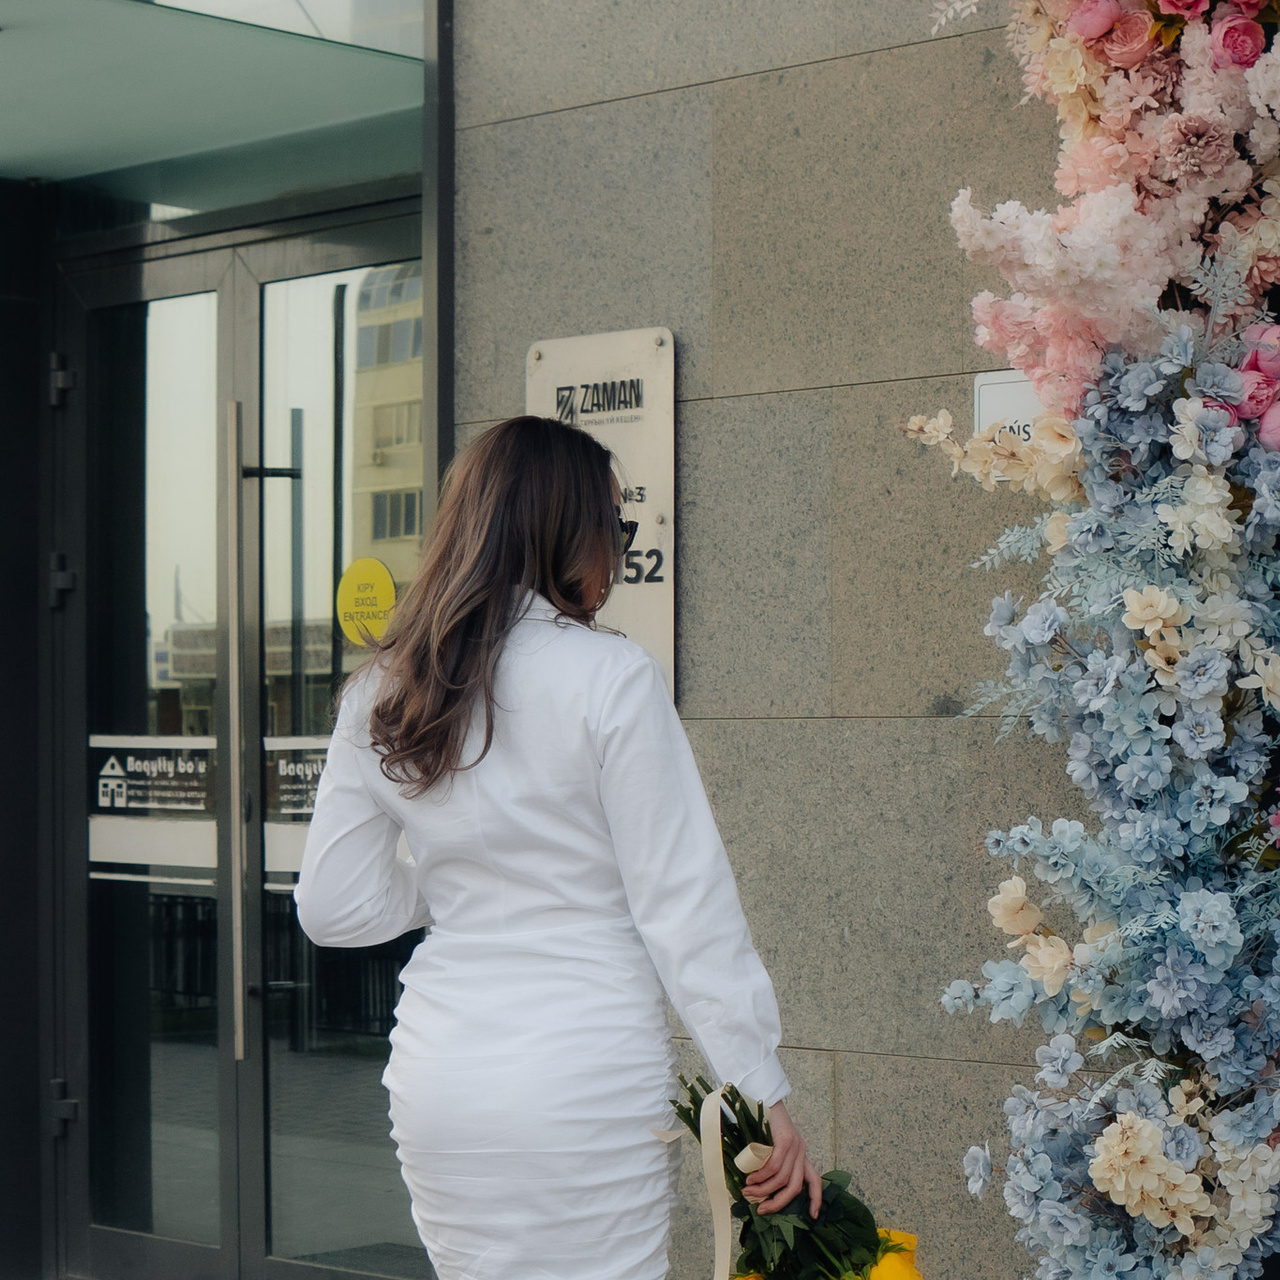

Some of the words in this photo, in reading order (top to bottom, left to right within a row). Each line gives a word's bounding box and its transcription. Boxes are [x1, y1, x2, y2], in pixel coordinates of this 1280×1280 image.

[580, 378, 644, 414] ZAMAN
[354, 596, 378, 608] ВХОД
[344, 610, 389, 622] ENTRANCE
